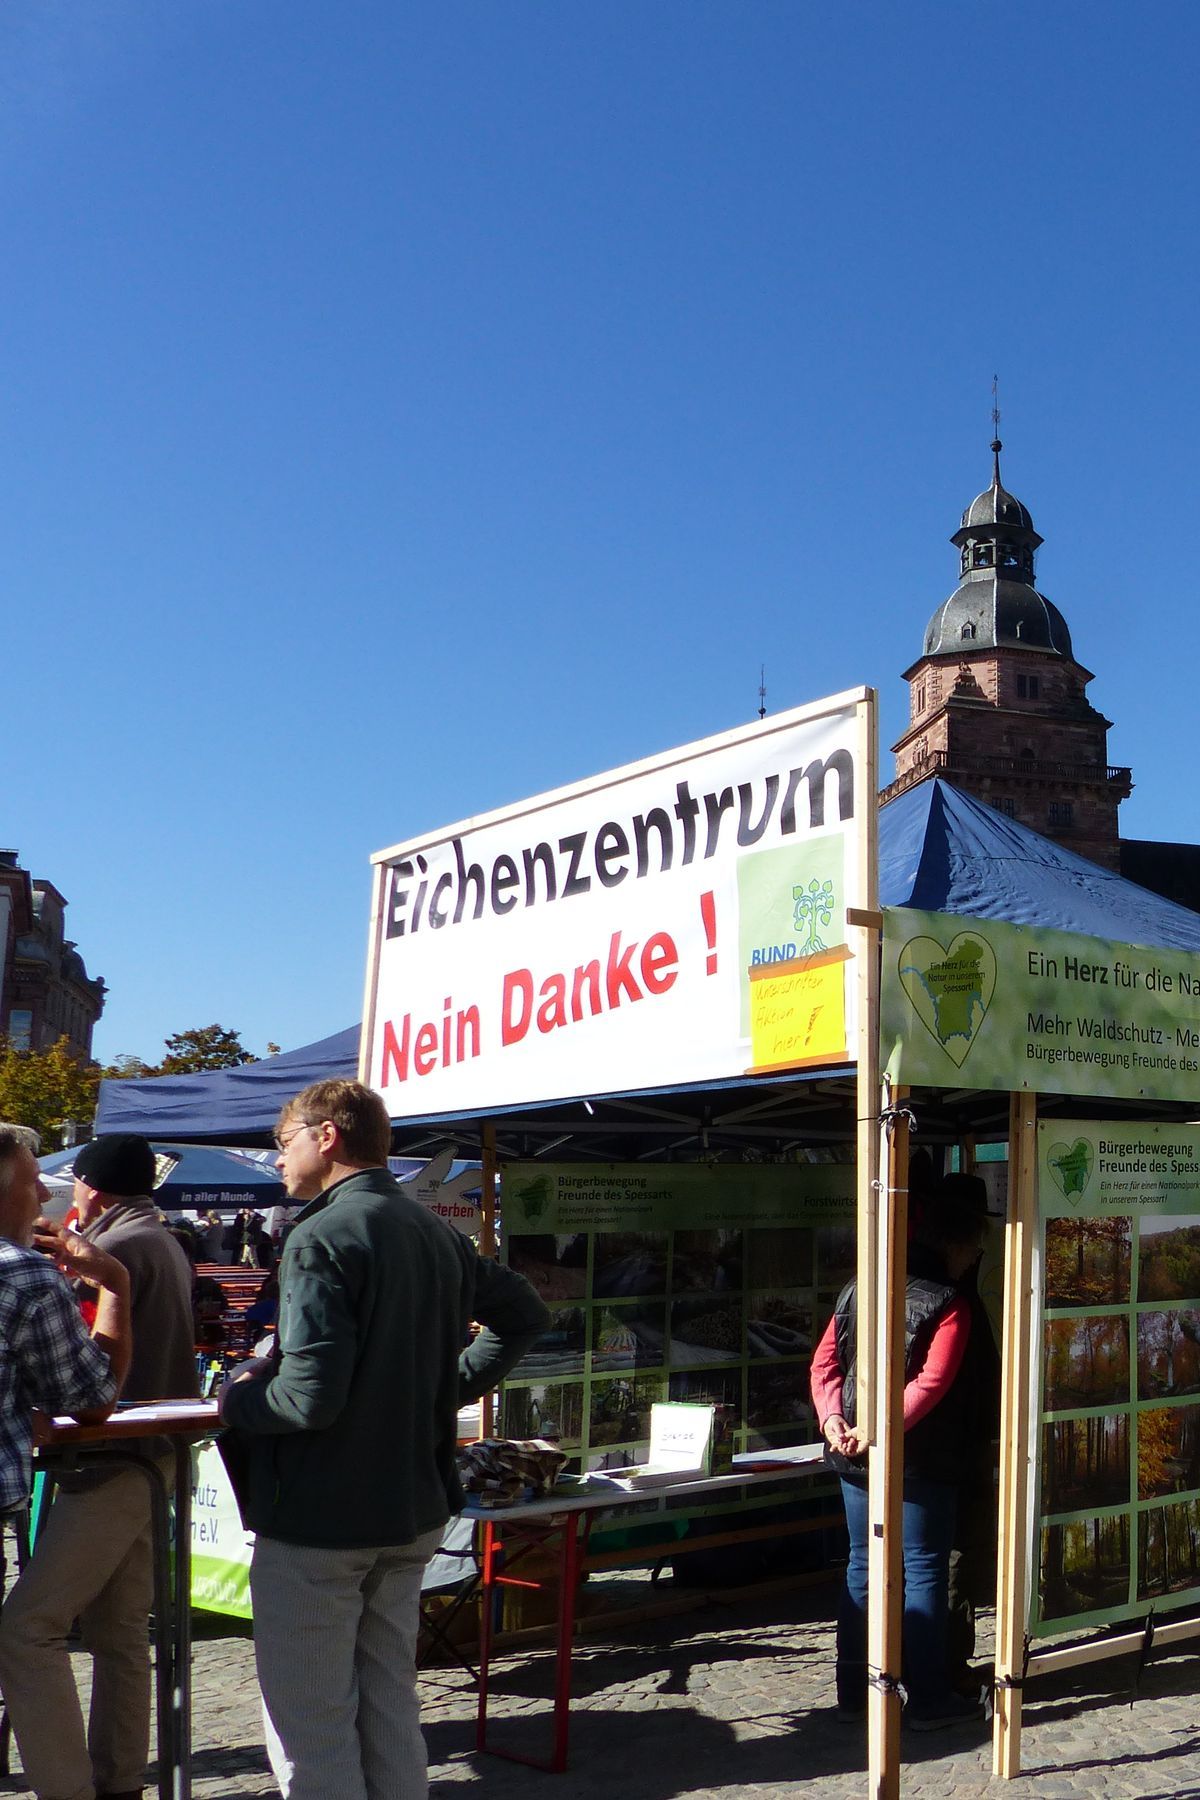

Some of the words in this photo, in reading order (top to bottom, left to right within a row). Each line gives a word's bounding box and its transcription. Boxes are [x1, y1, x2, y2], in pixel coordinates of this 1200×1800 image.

[386, 749, 854, 940] Eichenzentrum
[752, 943, 797, 966] BUND
[1028, 951, 1058, 979] Ein
[1064, 956, 1109, 985] Herz
[1113, 962, 1139, 989] für
[1145, 967, 1173, 993] die
[381, 995, 480, 1088] Nein
[502, 930, 679, 1048] Danke
[1027, 1013, 1072, 1036] Mehr
[1077, 1017, 1163, 1045] Waldschutz
[1026, 1043, 1130, 1069] Bürgerbewegung
[1132, 1052, 1176, 1070] Freunde
[1179, 1056, 1198, 1072] des
[1099, 1141, 1193, 1158] Bürgerbewegung
[1099, 1159, 1147, 1173] Freunde
[1149, 1159, 1168, 1173] des
[558, 1176, 648, 1189] Bürgerbewegung
[1100, 1181, 1111, 1190] Ein
[1113, 1181, 1128, 1190] Herz
[1129, 1180, 1140, 1191] für
[1158, 1180, 1200, 1192] Nationalpark
[194, 1192, 219, 1202] aller
[558, 1190, 601, 1201] Freunde
[604, 1189, 622, 1200] des
[625, 1190, 673, 1201] Spessarts
[1109, 1196, 1138, 1204] unserem
